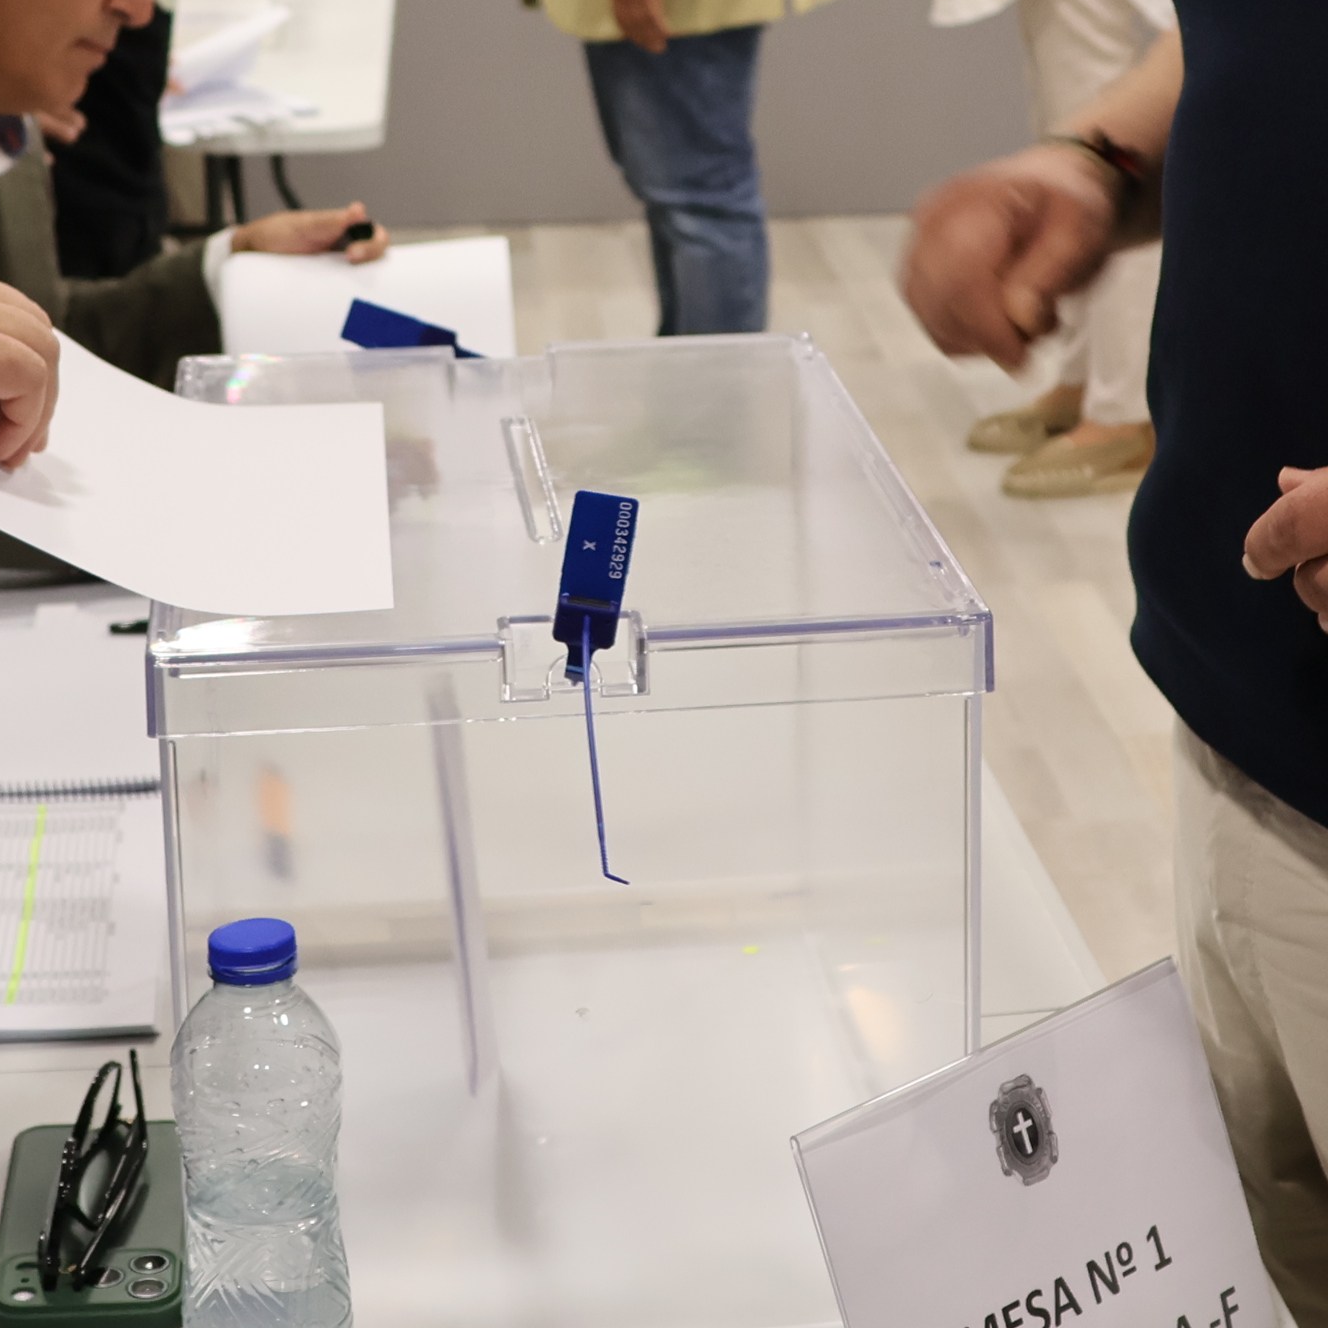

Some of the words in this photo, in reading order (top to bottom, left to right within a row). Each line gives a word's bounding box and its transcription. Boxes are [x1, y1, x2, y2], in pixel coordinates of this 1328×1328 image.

[609, 501, 633, 580] 000342929
[964, 1275, 1083, 1328] ESA
[1146, 1224, 1173, 1272] 1
